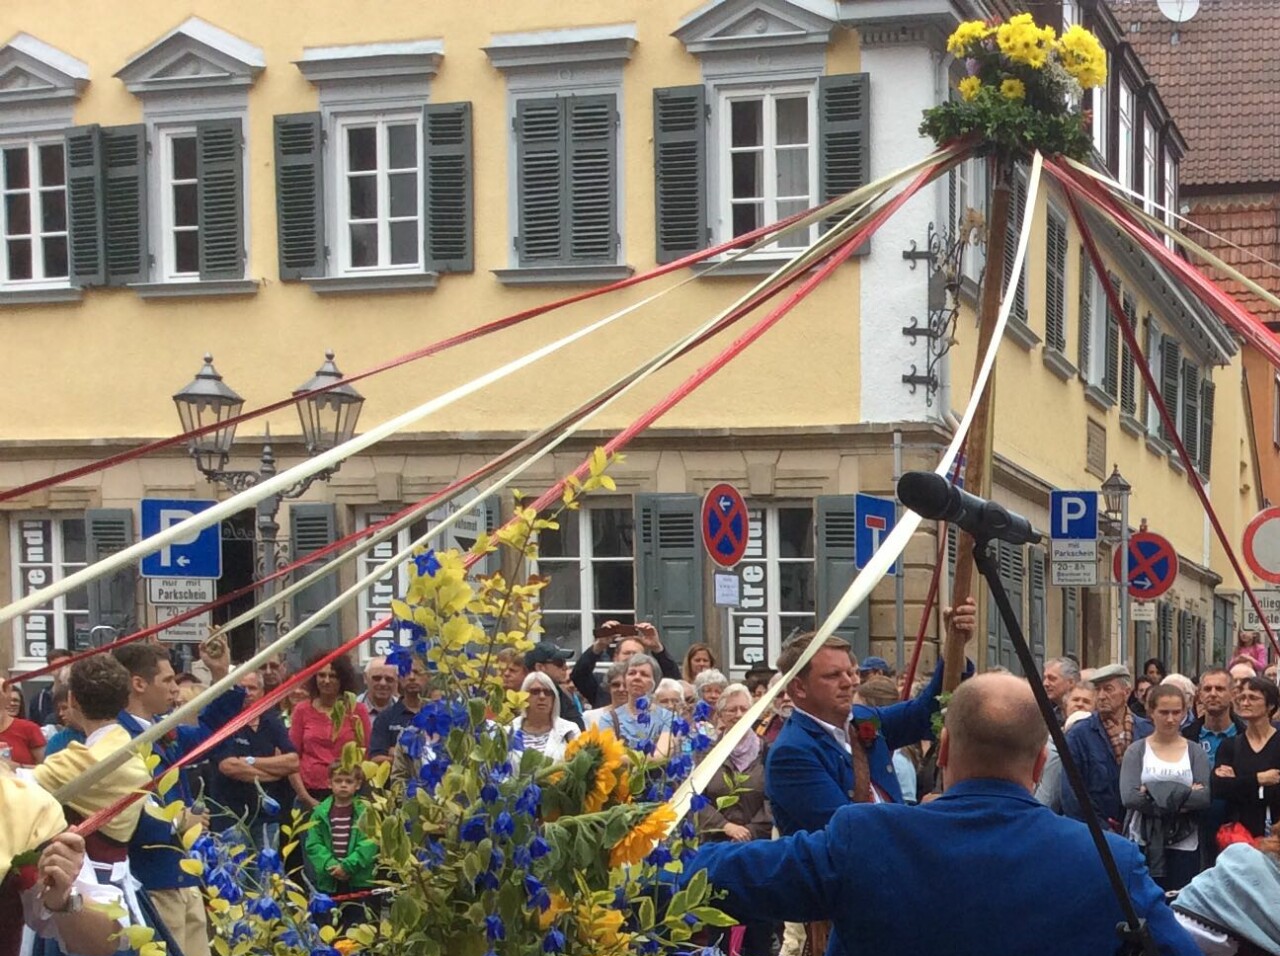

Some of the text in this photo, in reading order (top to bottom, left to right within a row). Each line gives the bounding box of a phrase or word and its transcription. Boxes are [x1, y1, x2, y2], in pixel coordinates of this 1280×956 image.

[1061, 496, 1087, 534] P
[160, 508, 202, 567] P
[158, 588, 207, 600] Parkschein
